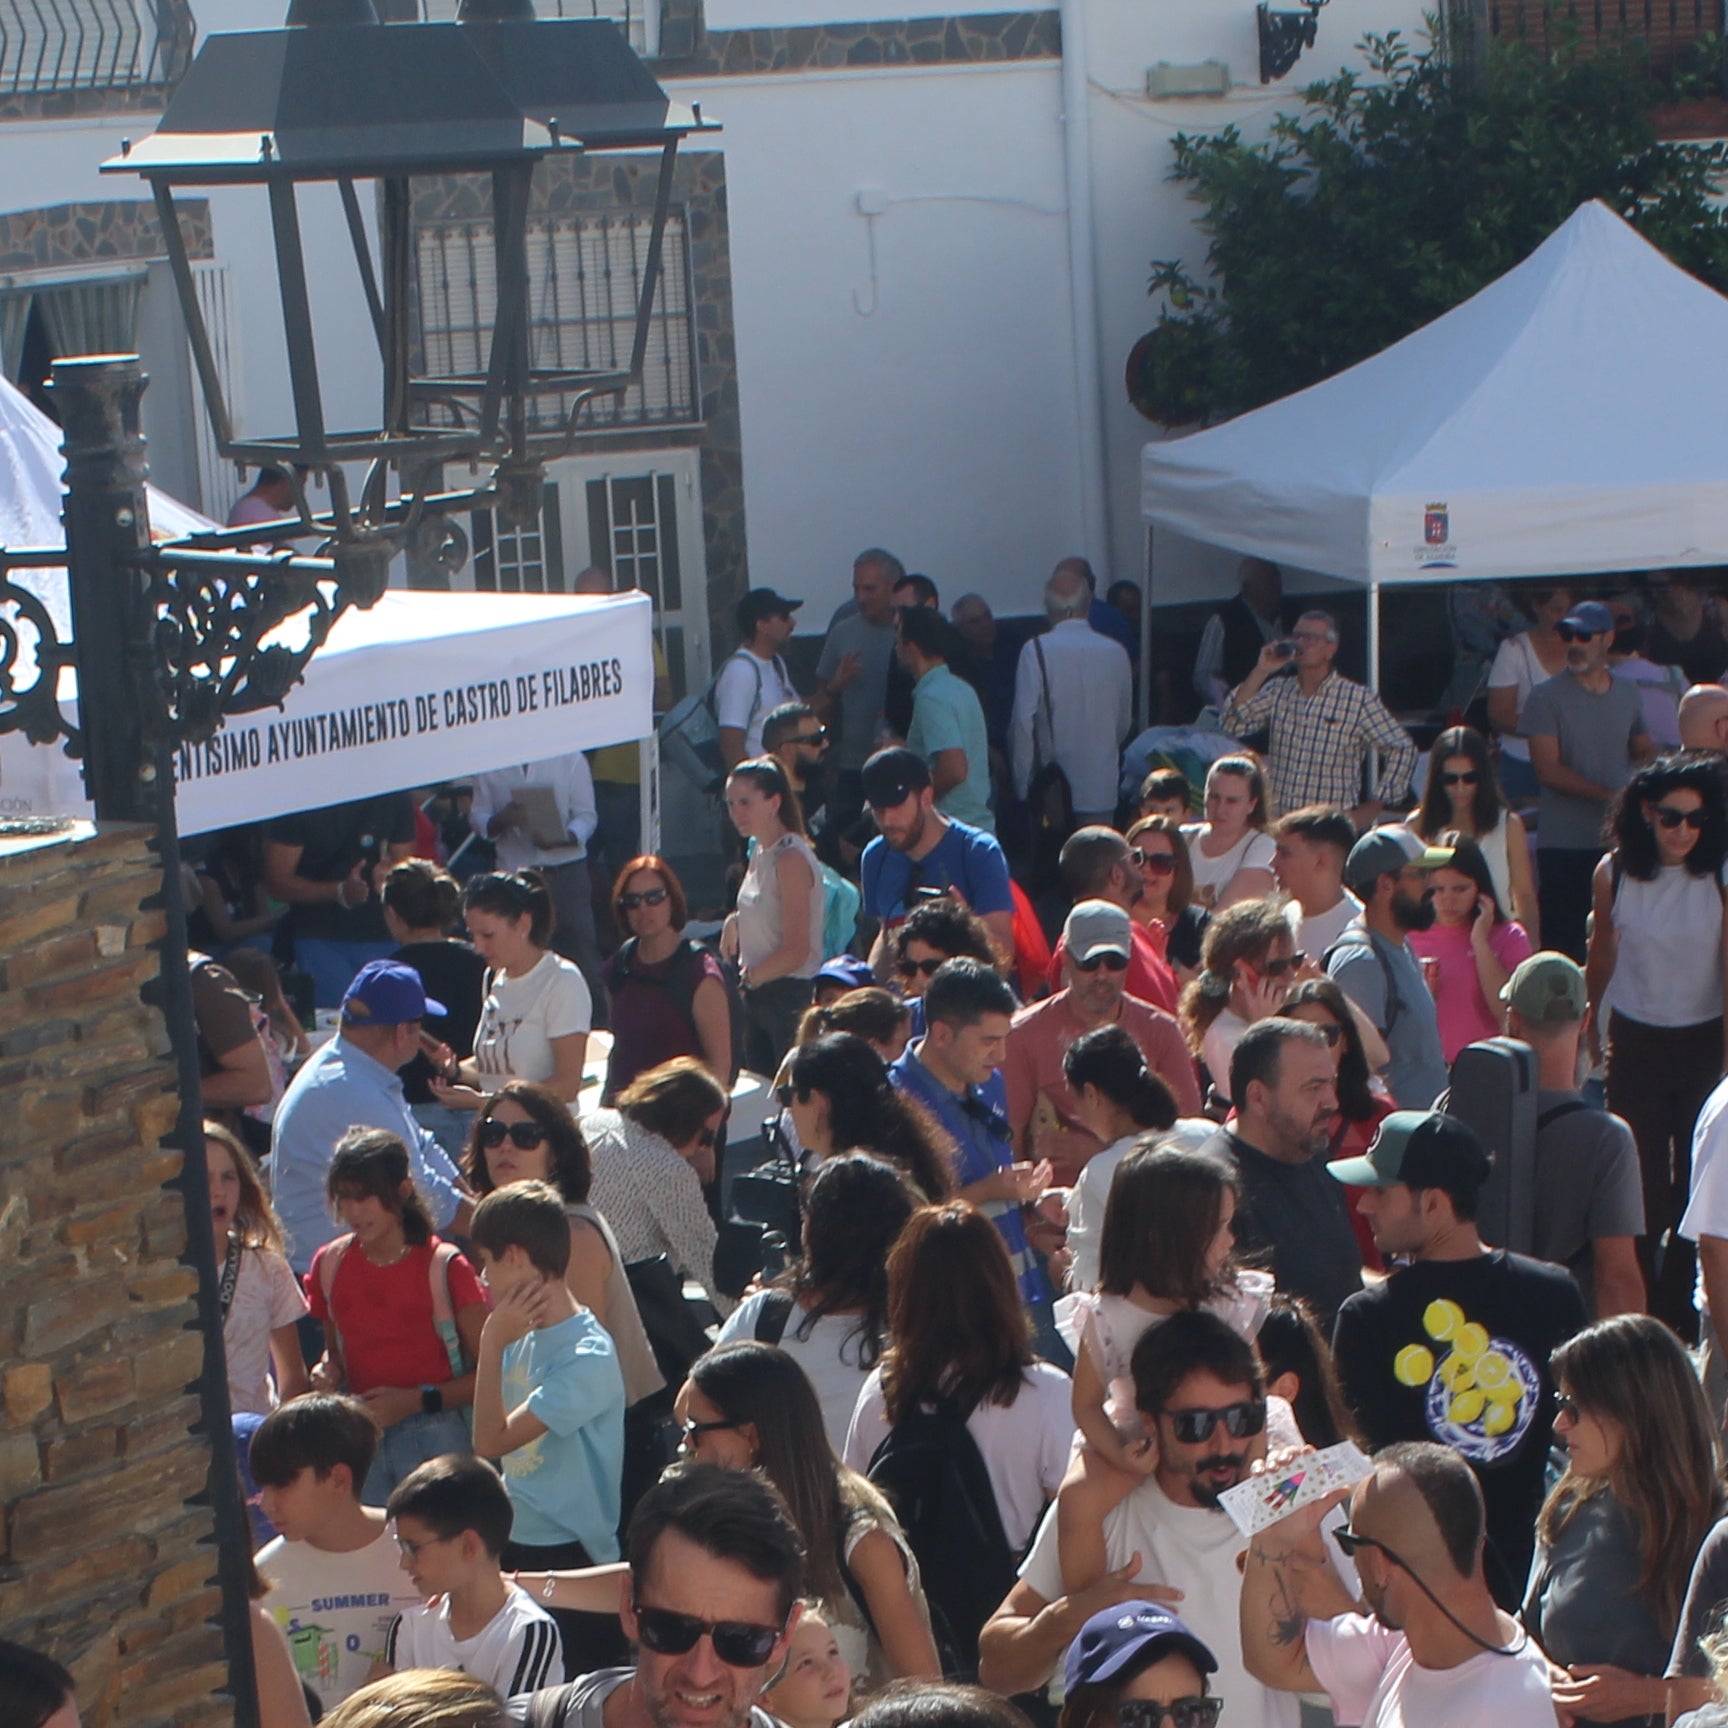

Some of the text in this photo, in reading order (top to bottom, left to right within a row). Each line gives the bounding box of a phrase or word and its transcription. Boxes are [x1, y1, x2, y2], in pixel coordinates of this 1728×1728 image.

[172, 657, 624, 784] ENTISIMO AYUNTAMIENTO DE CASTRO DE FILABRES
[312, 1592, 390, 1612] SUMMER
